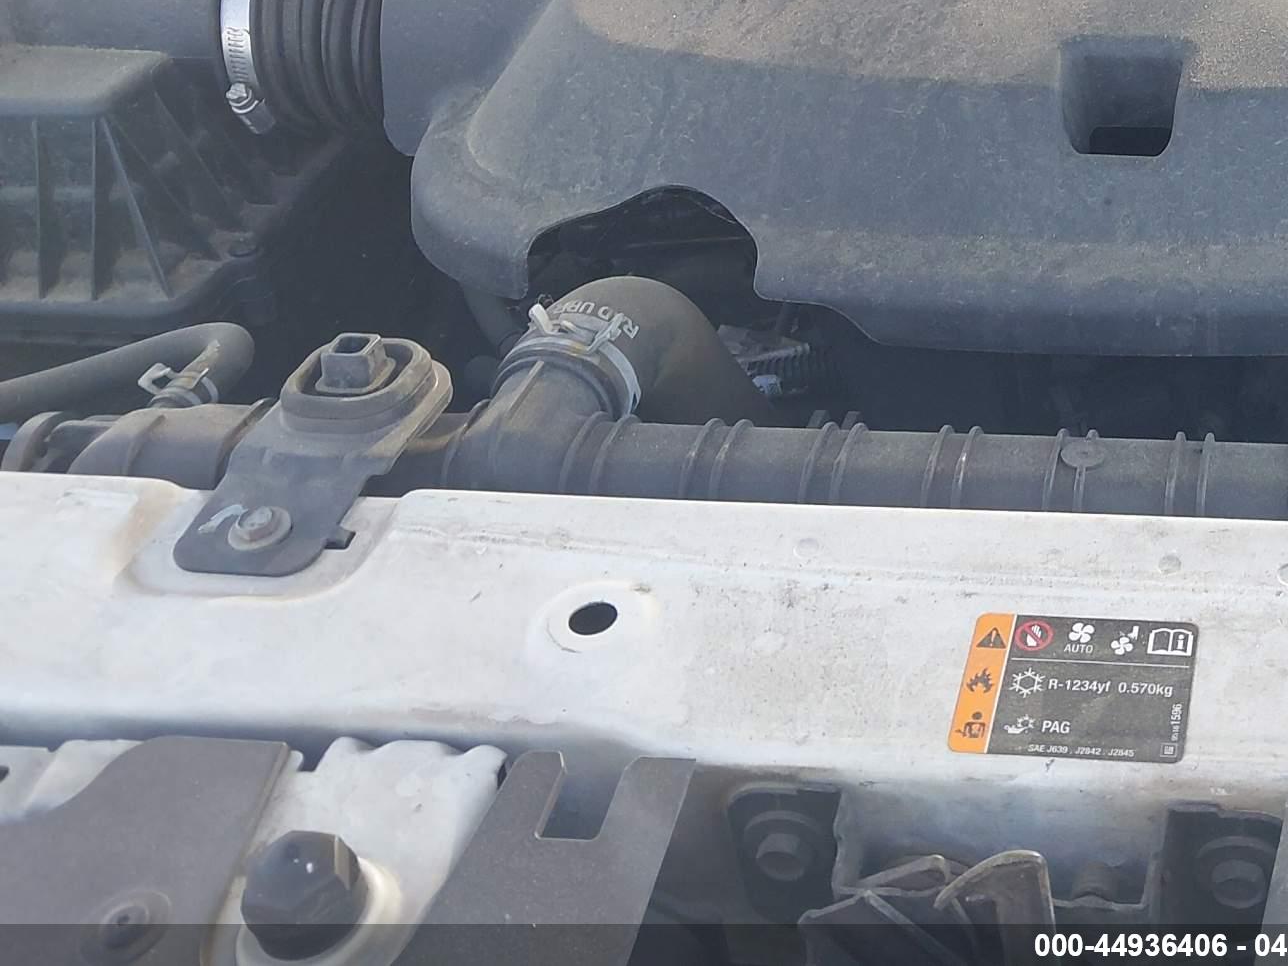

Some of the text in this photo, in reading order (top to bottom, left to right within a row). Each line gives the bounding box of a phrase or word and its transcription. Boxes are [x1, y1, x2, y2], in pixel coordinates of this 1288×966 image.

[1063, 643, 1094, 654] AUTO
[1048, 678, 1174, 698] R-1234yf 0.570kg
[1041, 720, 1071, 734] PAG
[1027, 743, 1046, 753] SAE
